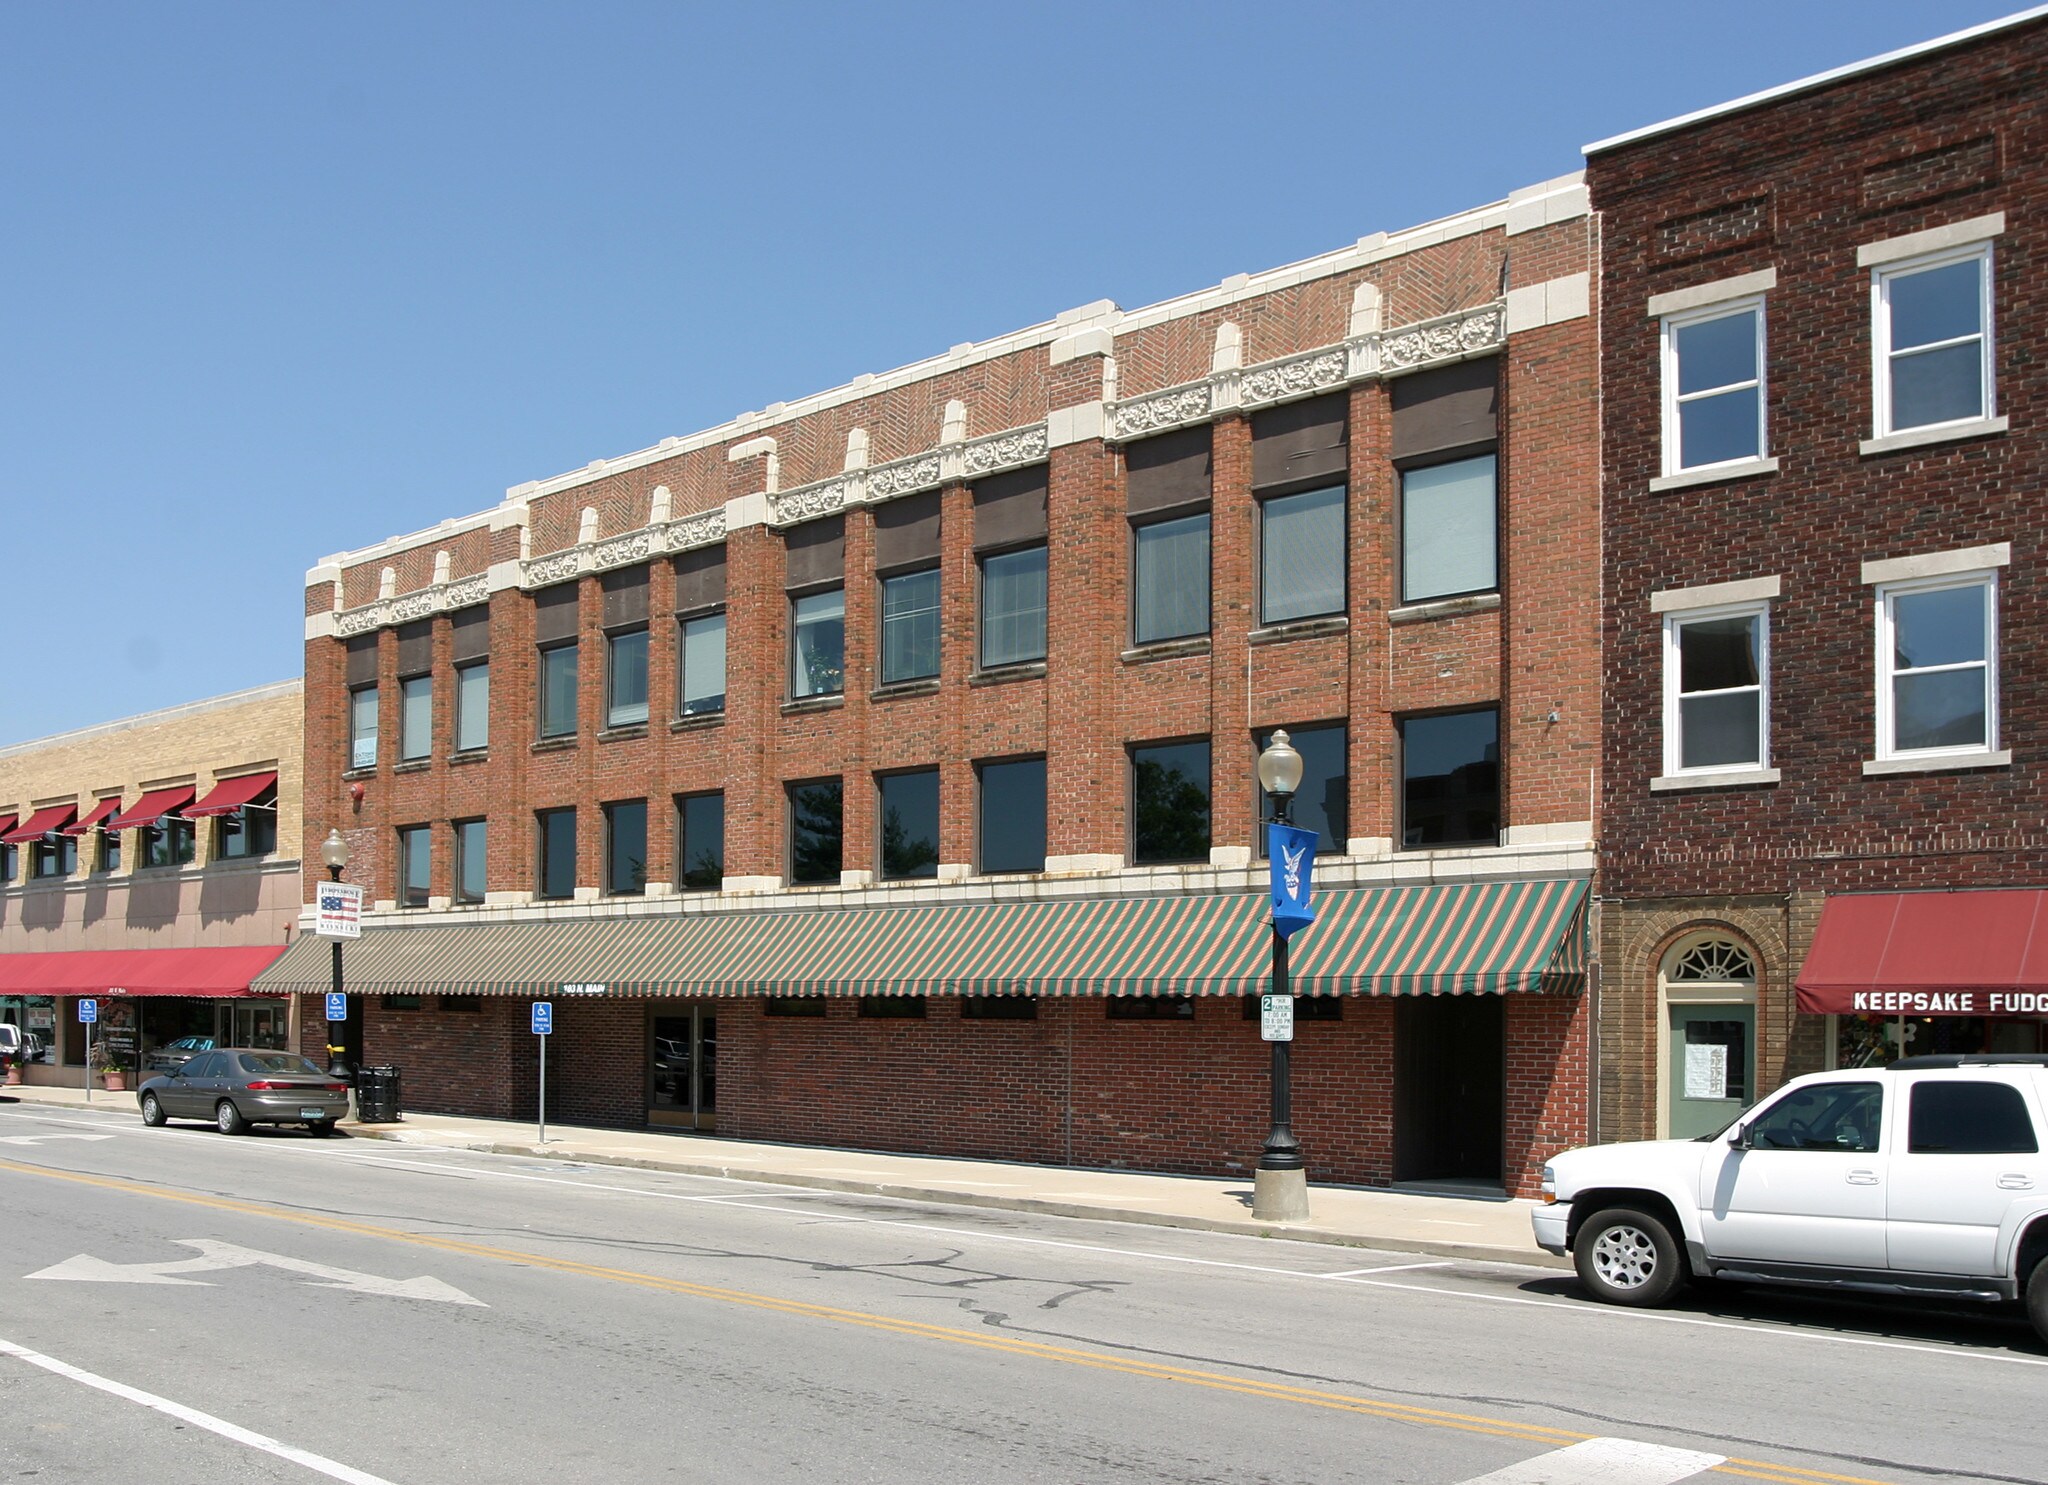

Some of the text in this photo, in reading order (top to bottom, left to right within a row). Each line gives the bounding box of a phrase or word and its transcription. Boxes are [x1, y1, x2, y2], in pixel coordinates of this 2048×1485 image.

[585, 984, 606, 993] MAIN
[1264, 998, 1271, 1010] 2
[1854, 992, 2048, 1012] KEEPSAKE FUDG
